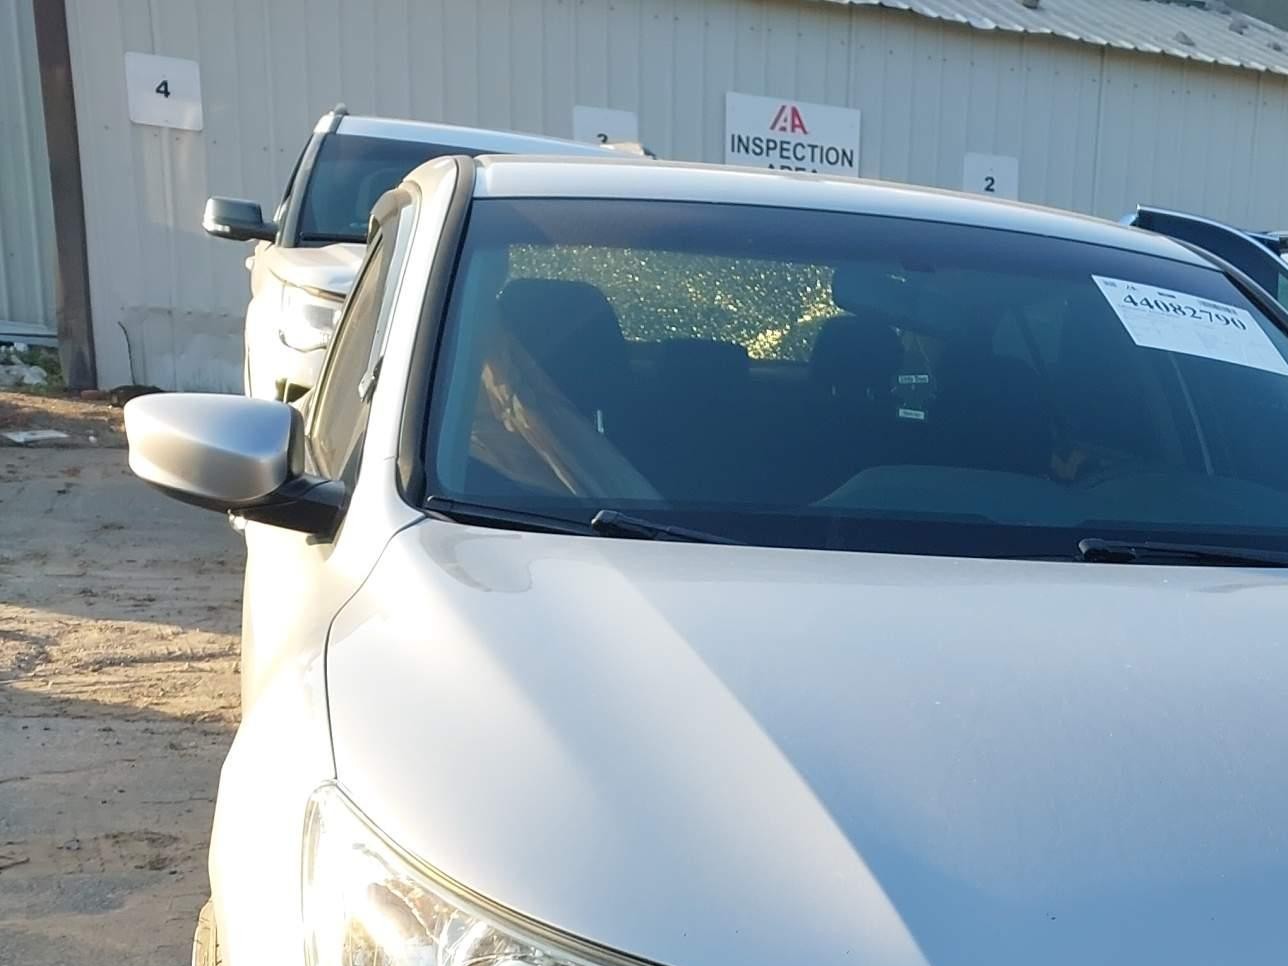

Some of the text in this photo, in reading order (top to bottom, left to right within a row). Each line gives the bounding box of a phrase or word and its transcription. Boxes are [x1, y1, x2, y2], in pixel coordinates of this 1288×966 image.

[155, 79, 171, 98] 4
[730, 133, 854, 168] INSPECTION
[984, 176, 995, 192] 2
[1122, 293, 1248, 331] 44082790
